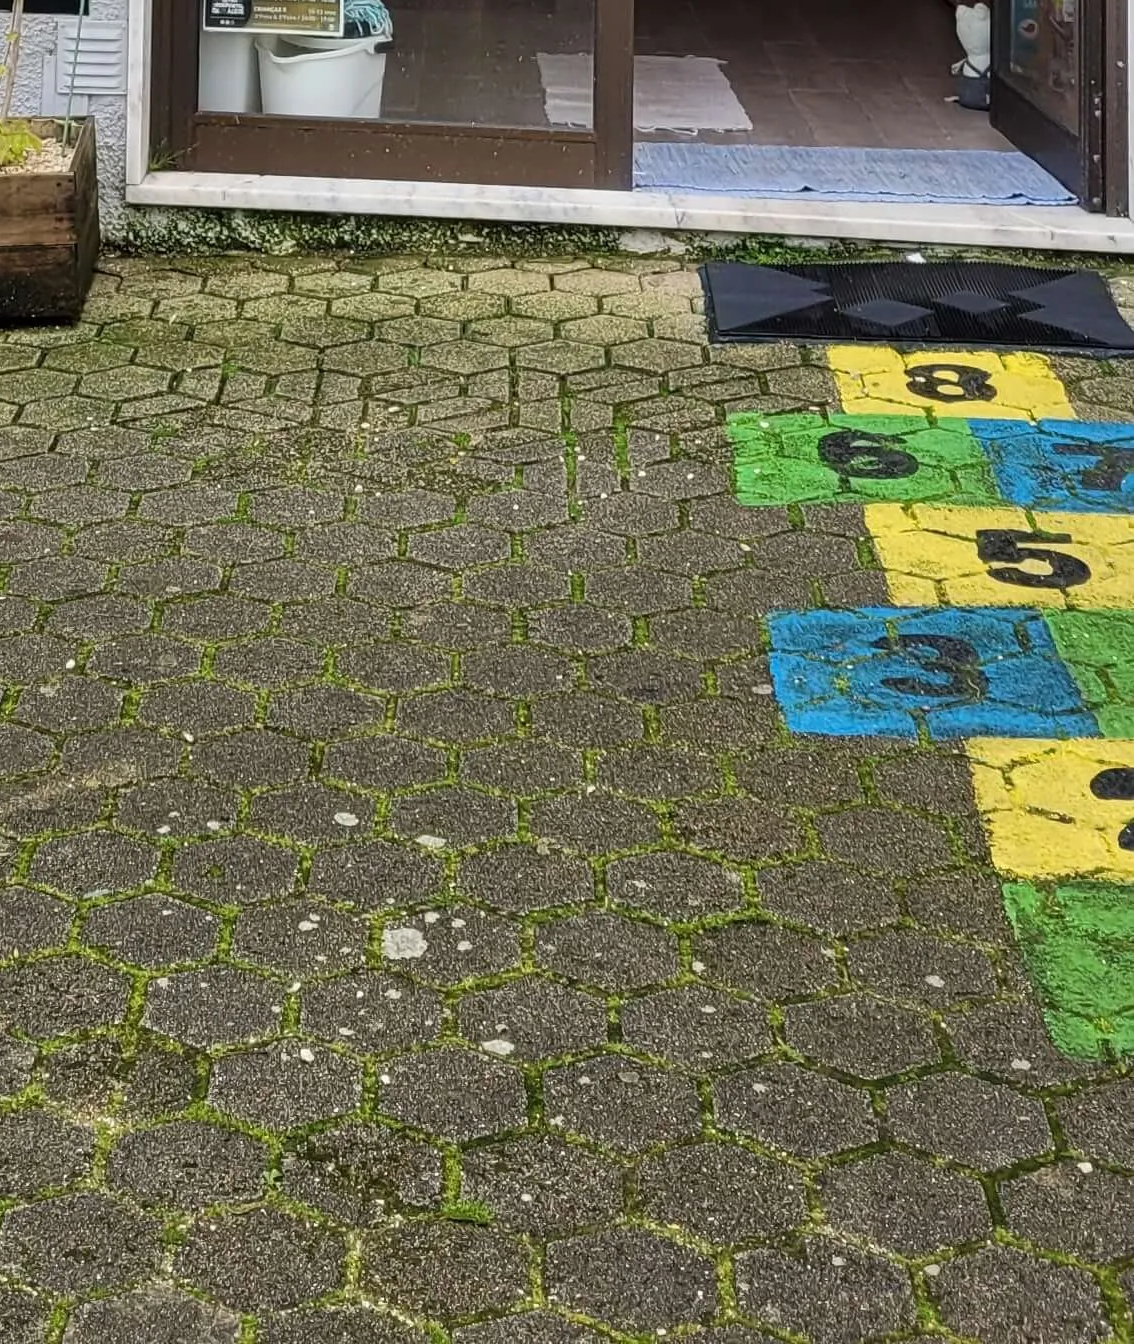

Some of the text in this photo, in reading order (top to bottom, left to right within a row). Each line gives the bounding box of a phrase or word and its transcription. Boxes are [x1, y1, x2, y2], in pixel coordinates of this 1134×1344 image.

[904, 364, 998, 403] 8
[817, 430, 919, 480] 6
[976, 529, 1092, 589] 5
[869, 634, 989, 698] 3
